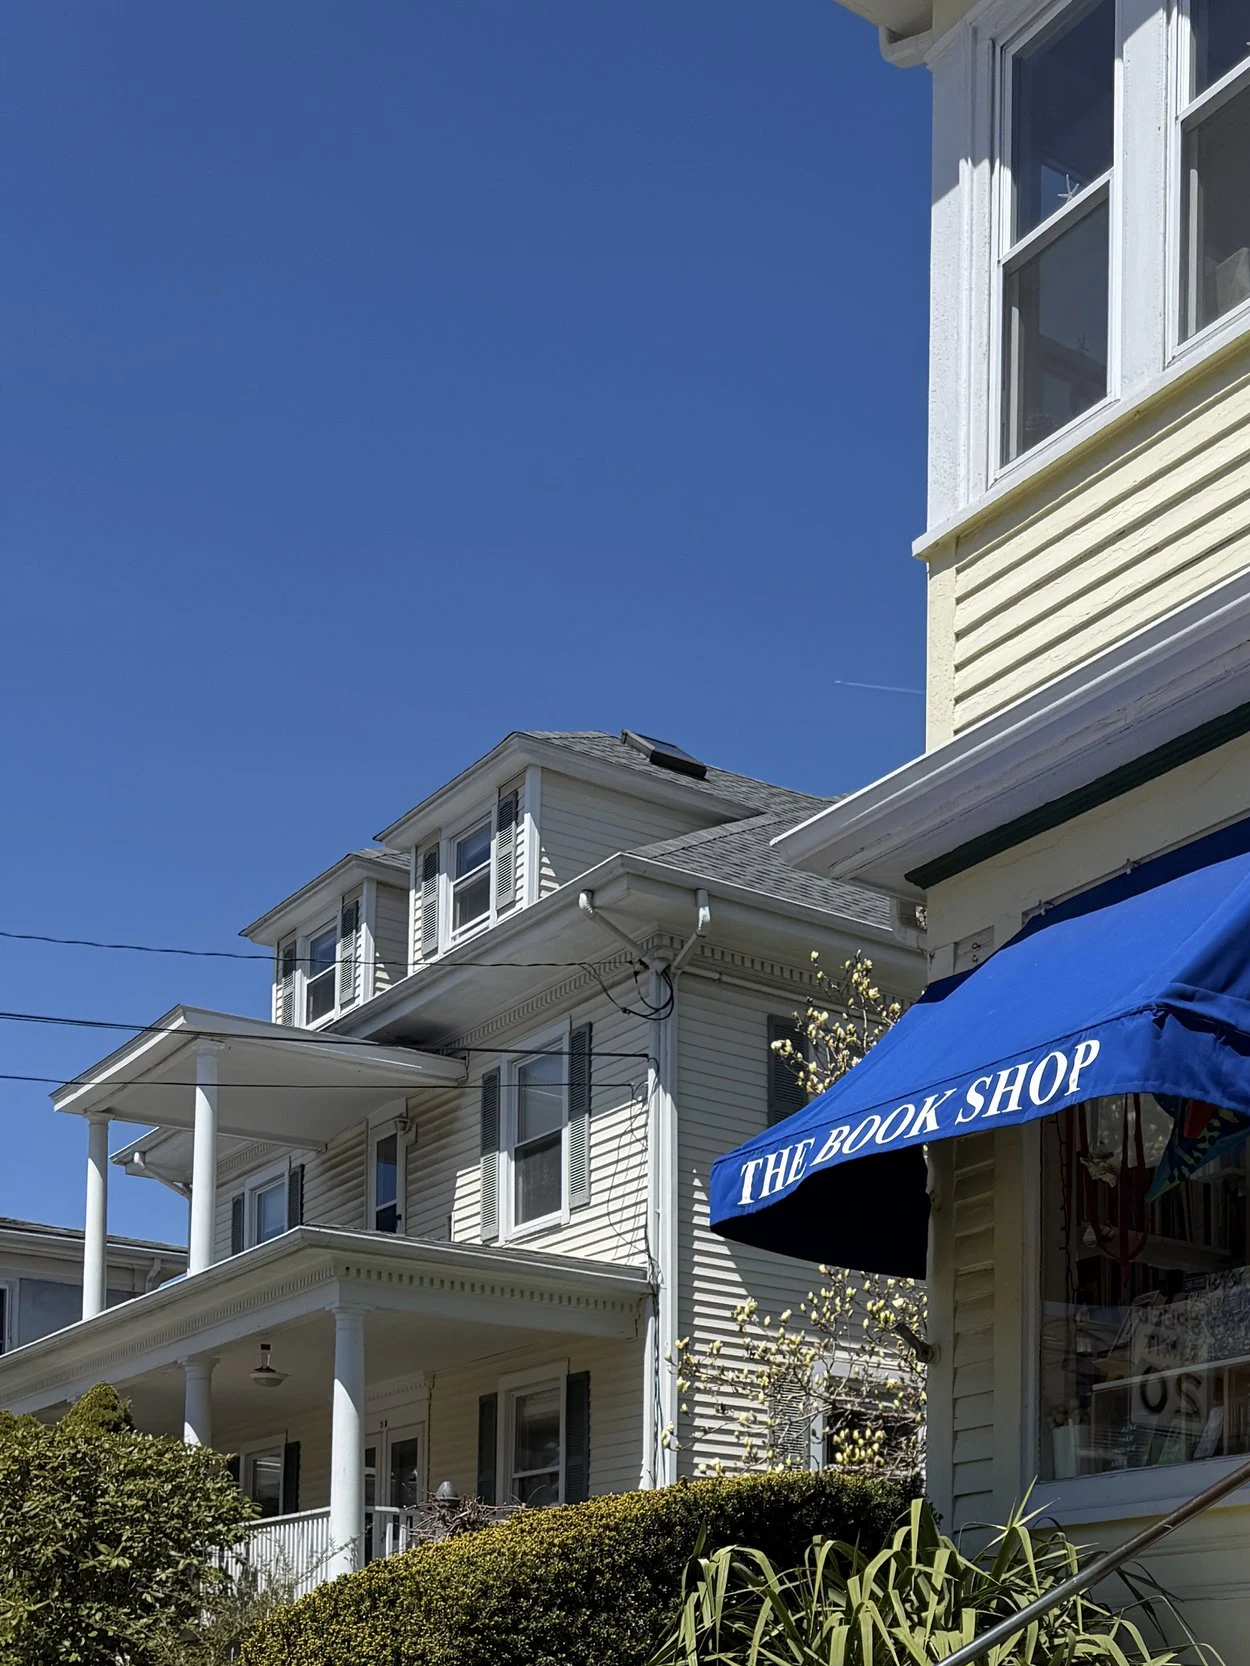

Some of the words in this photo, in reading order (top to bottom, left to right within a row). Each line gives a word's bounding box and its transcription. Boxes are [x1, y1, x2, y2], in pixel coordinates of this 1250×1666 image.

[737, 1137, 814, 1205] THE
[811, 1088, 957, 1166] BOOK
[955, 1039, 1100, 1125] SHOP
